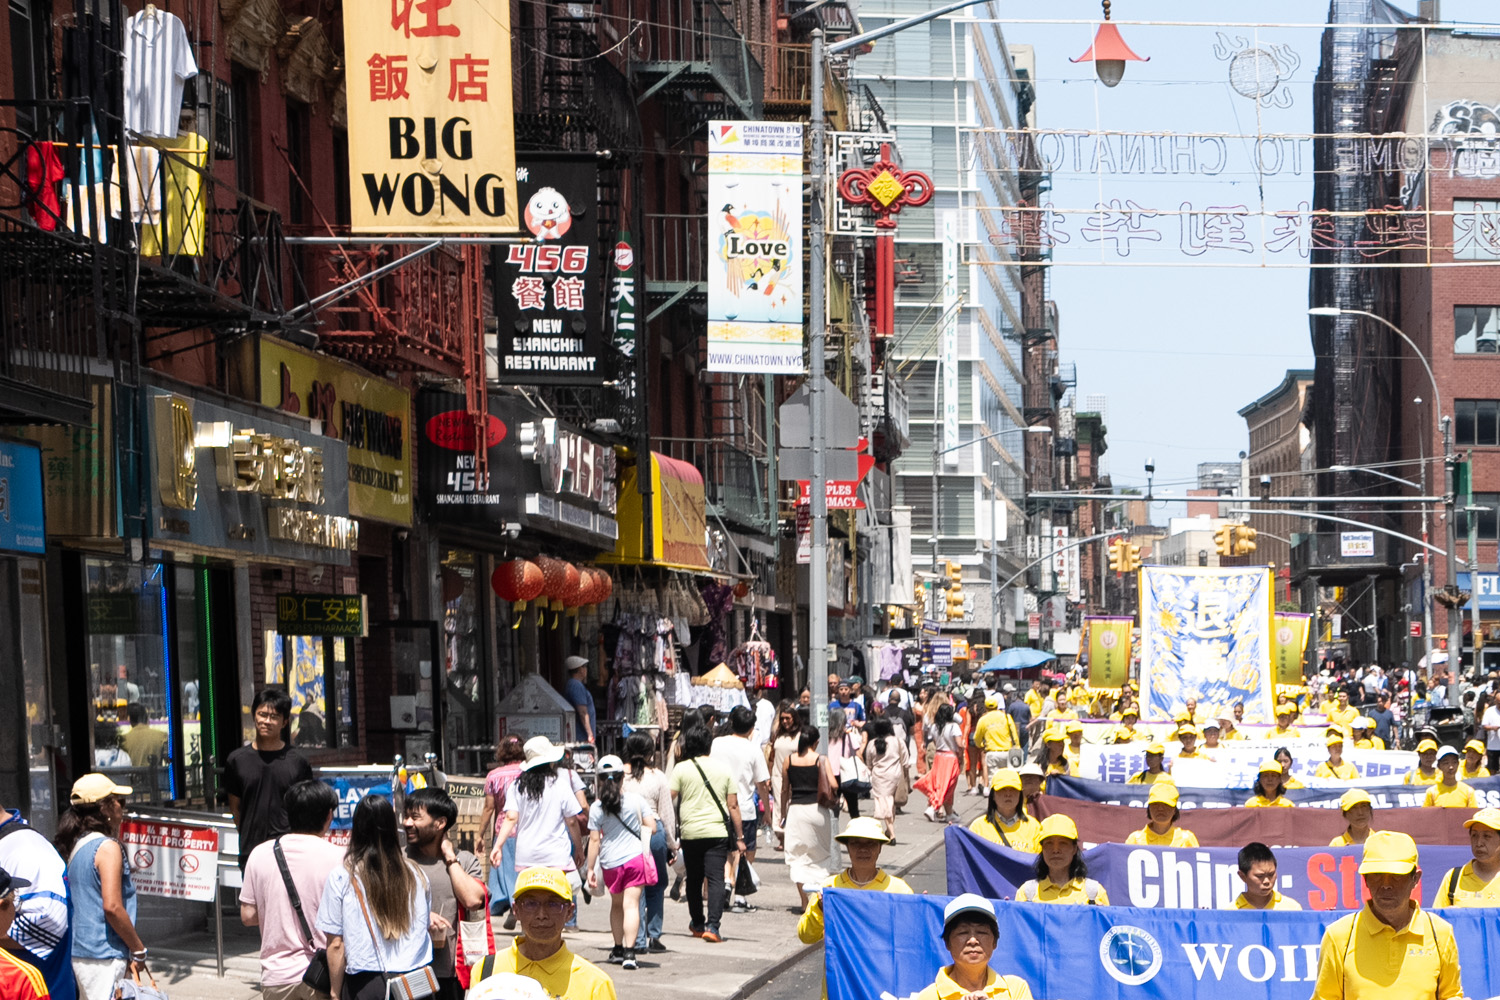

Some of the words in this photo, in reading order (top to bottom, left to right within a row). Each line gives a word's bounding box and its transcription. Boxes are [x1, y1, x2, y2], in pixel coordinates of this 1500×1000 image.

[367, 53, 489, 102] 飯店
[389, 117, 472, 160] BIG
[743, 126, 785, 134] CHINATOWN
[362, 173, 506, 216] WONG
[730, 237, 787, 256] Love
[505, 245, 589, 273] 456
[512, 276, 585, 311] 餐館
[533, 319, 562, 333] NEW
[513, 337, 583, 352] SHANGHAI
[504, 355, 596, 371] RESTAURANT
[805, 485, 852, 495] PPLES
[315, 624, 361, 633] PHARMACY
[448, 783, 468, 795] DIM
[122, 832, 163, 846] PRIVATE
[164, 836, 215, 851] PROPERTY
